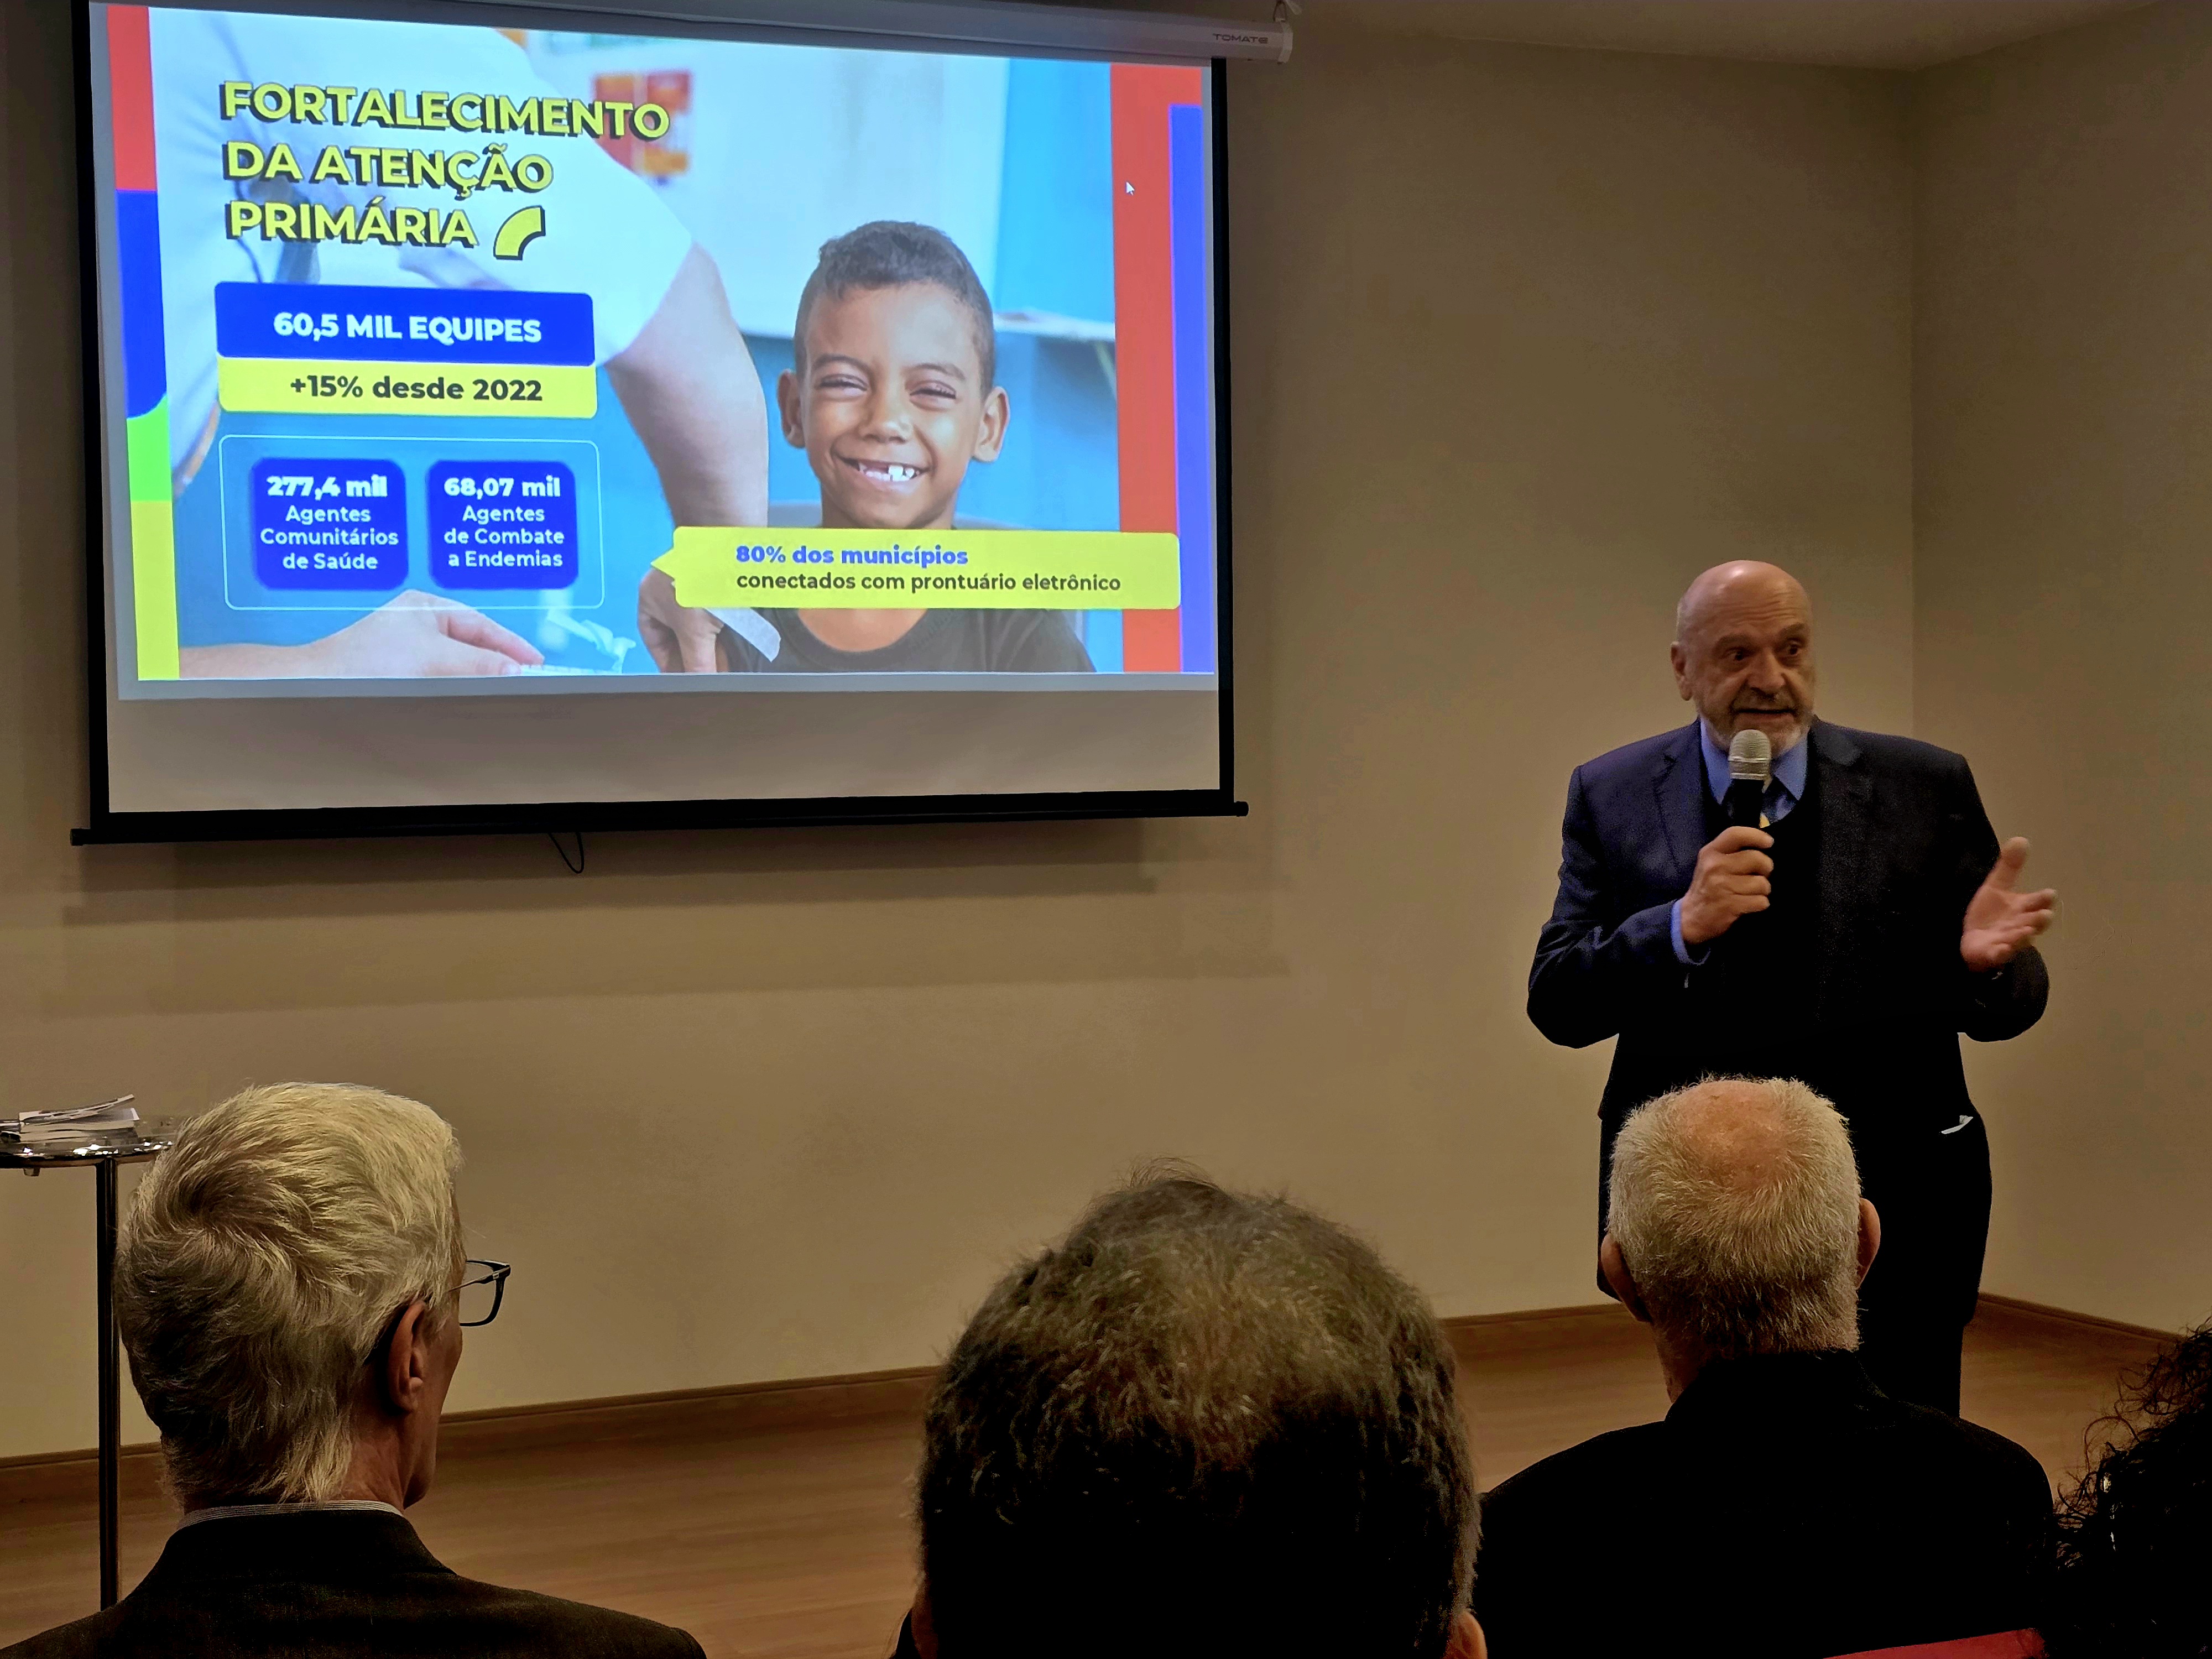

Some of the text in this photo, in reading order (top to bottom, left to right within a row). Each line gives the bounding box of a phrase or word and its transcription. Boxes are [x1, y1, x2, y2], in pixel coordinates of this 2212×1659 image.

[1213, 33, 1269, 44] TOMATE
[221, 80, 670, 140] FORTALECIMENTO
[223, 140, 554, 201] DA ATENÇÃO
[224, 196, 480, 248] PRIMÁRIA
[274, 312, 542, 346] 60,5 MIL EQUIPES
[290, 375, 543, 401] +15% desde 2022
[267, 474, 388, 499] 277,4 mil
[444, 476, 561, 500] 68,07 mil
[285, 505, 372, 525] Agentes
[462, 505, 545, 525] Agentes
[260, 528, 399, 546] Comunitários
[444, 528, 565, 545] de Combate
[283, 551, 379, 570] de Saúde
[448, 551, 564, 568] a Endemias
[735, 545, 969, 568] 80% dos municípios
[735, 573, 1121, 594] conectados com prontuário eletrônico
